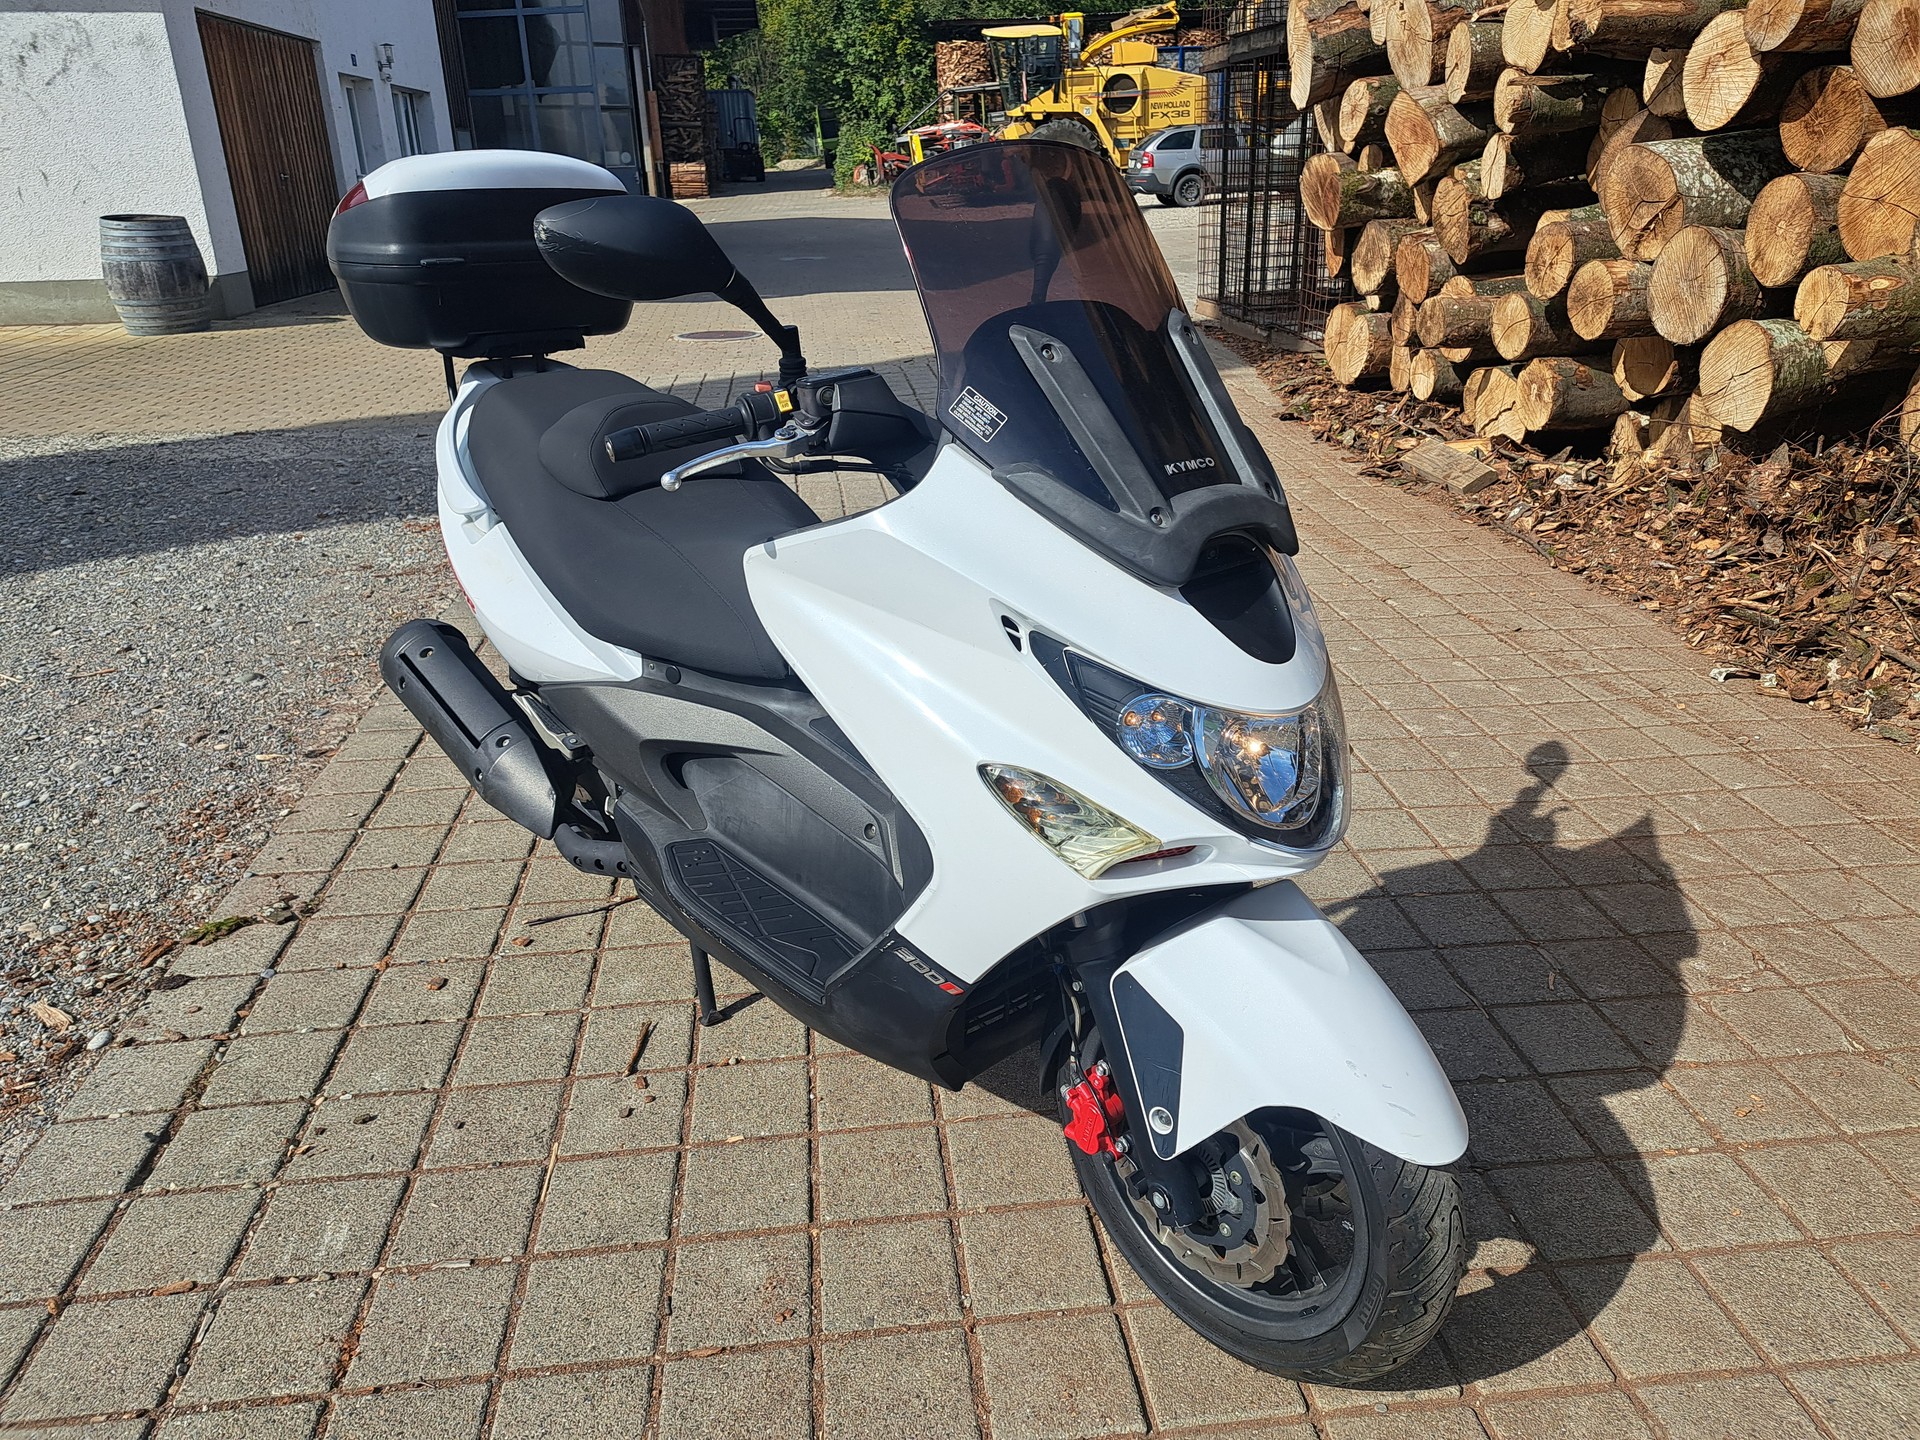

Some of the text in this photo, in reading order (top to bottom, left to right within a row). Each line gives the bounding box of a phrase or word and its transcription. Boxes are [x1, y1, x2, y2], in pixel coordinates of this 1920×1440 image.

[1150, 100, 1191, 110] NEW HOLLAND
[1150, 109, 1191, 120] FX38
[973, 394, 998, 417] CAUTION
[1164, 457, 1215, 476] KYMCO
